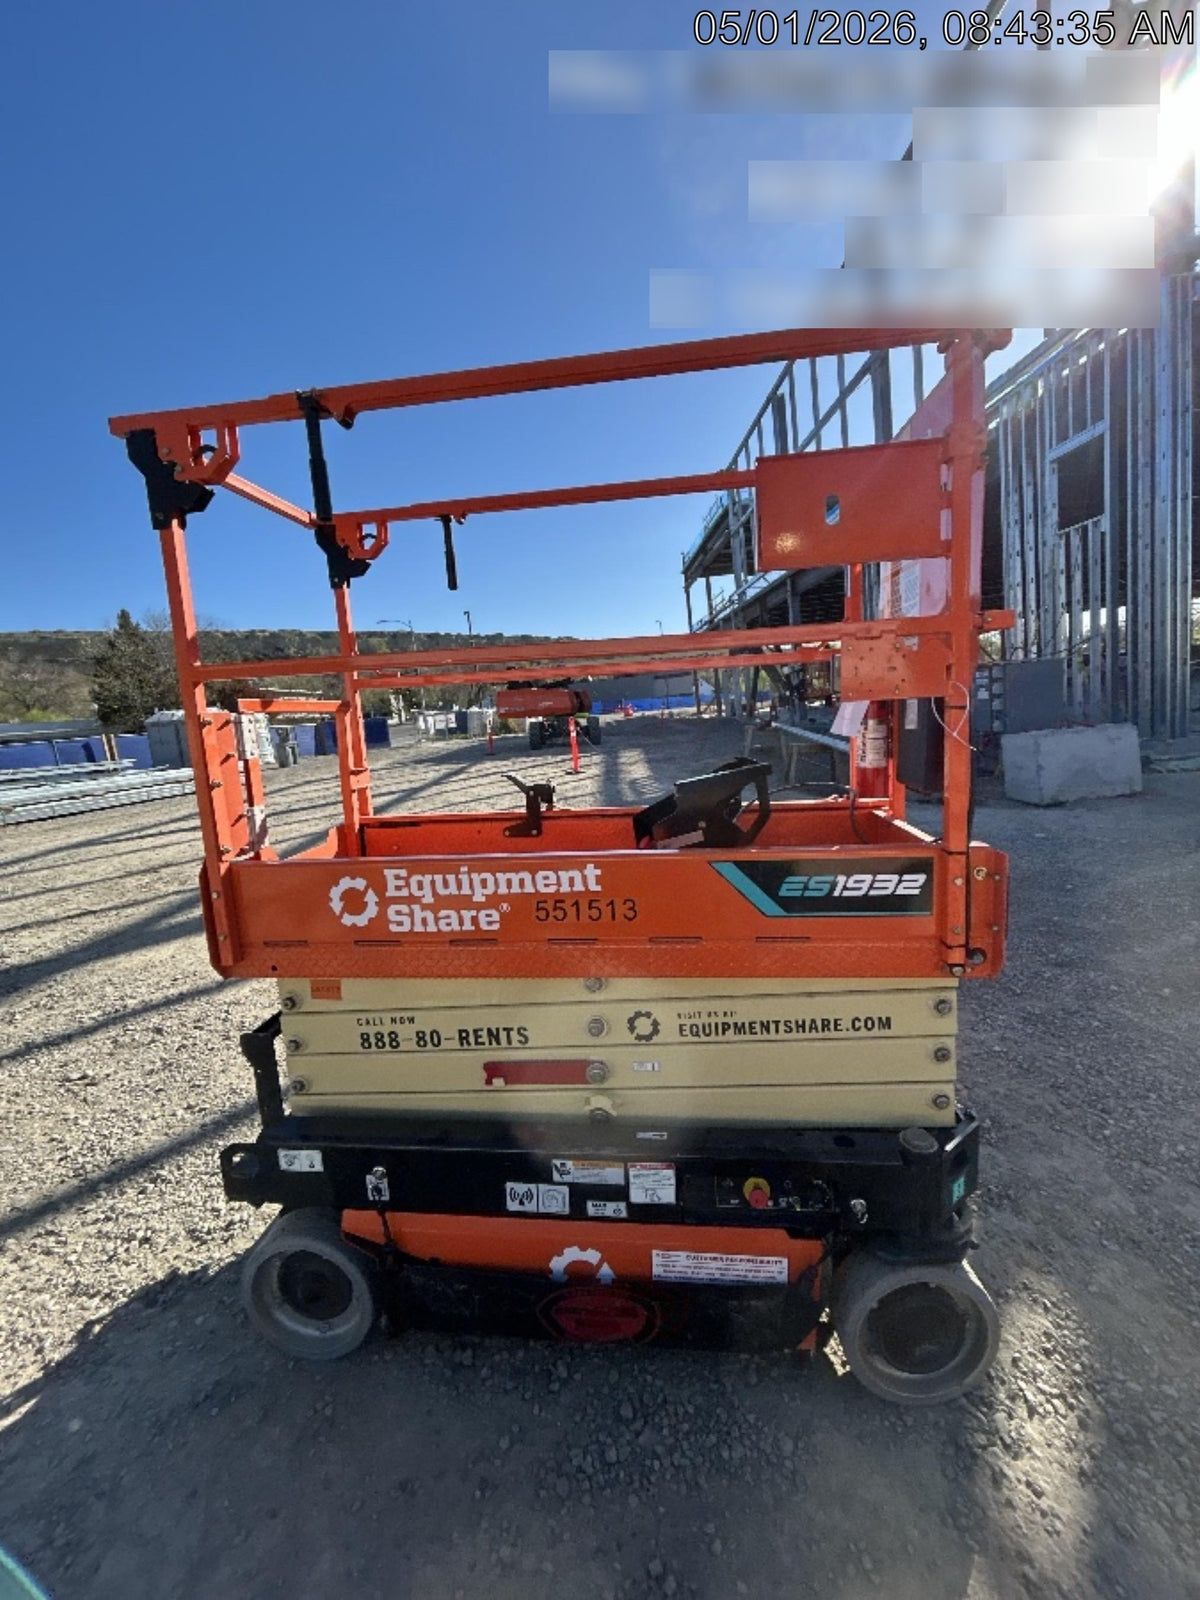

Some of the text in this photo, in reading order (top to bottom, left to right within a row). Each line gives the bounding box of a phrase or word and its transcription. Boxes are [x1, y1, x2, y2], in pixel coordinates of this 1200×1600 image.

[385, 864, 602, 903] Equipment
[778, 873, 927, 897] ES1932
[535, 899, 638, 922] 551513
[357, 1016, 415, 1026] CALL NOW
[678, 1016, 892, 1038] EQUIPMENTSHARE.COM
[360, 1026, 529, 1049] 888-80-RENTS
